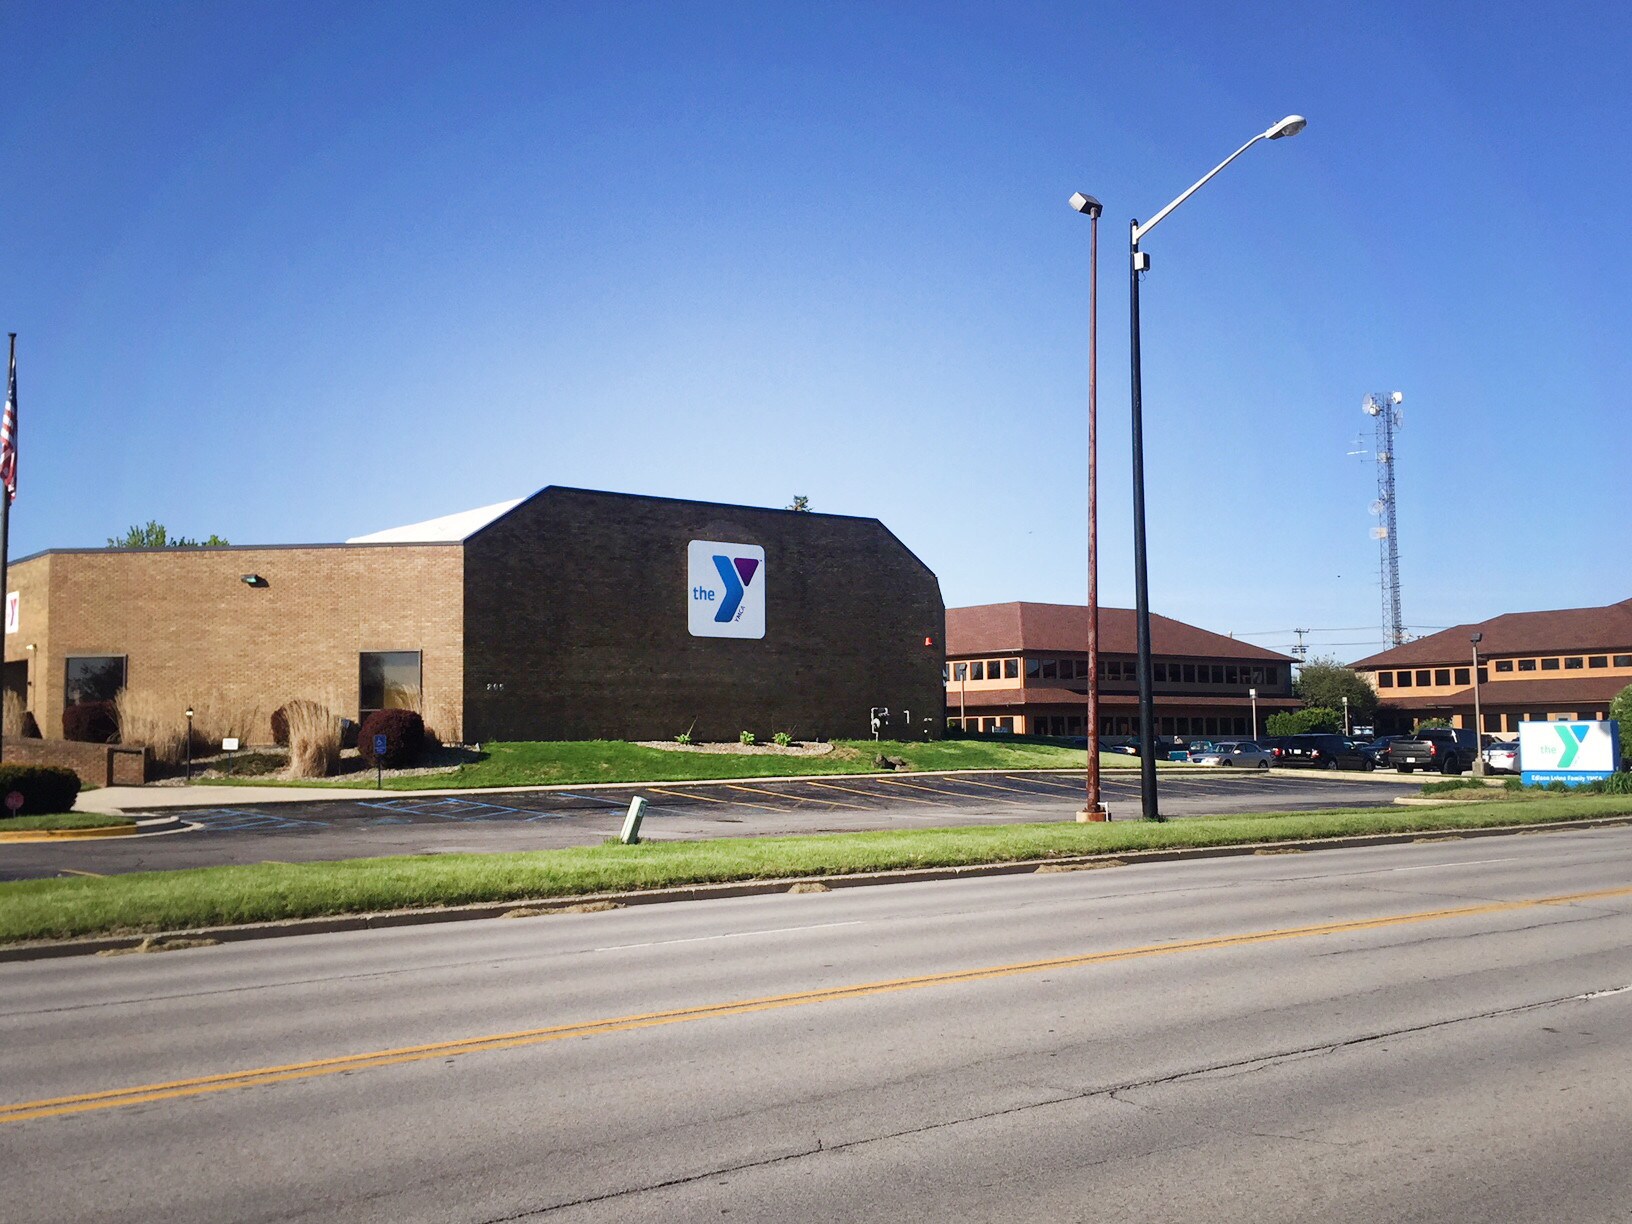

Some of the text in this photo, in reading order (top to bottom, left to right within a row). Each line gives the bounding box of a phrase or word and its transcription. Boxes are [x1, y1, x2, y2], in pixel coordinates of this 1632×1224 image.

[693, 586, 715, 601] the
[734, 605, 746, 622] YMCA
[1540, 745, 1557, 754] the
